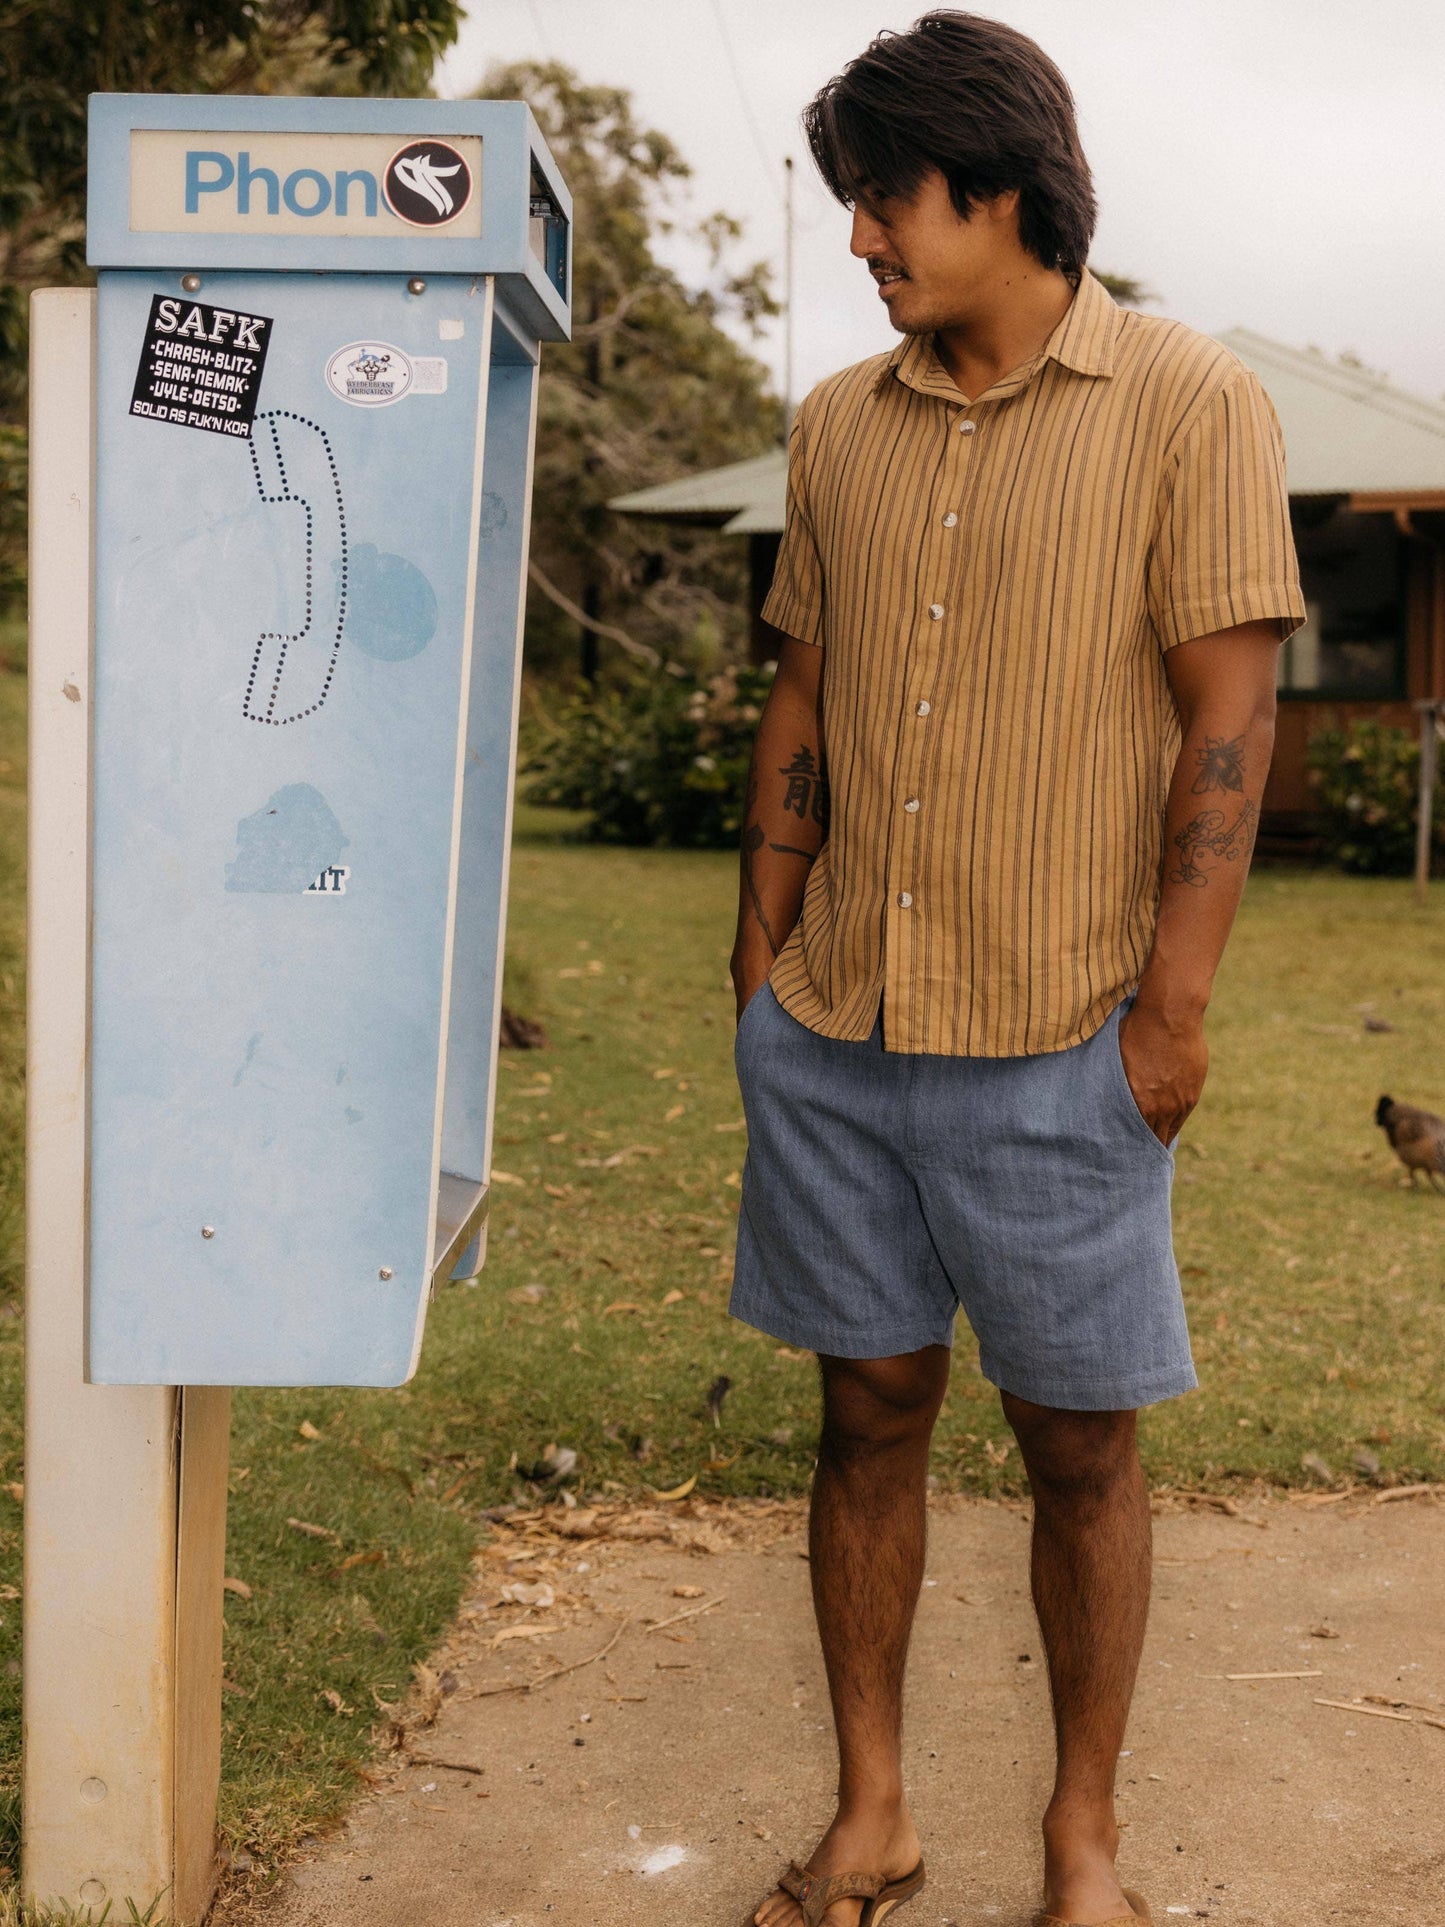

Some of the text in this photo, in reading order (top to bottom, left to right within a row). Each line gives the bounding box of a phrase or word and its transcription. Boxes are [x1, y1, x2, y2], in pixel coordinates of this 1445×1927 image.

[185, 151, 397, 217] Phon
[154, 299, 266, 352] SAFK
[132, 400, 250, 436] SOLID AS FUK'N KOA
